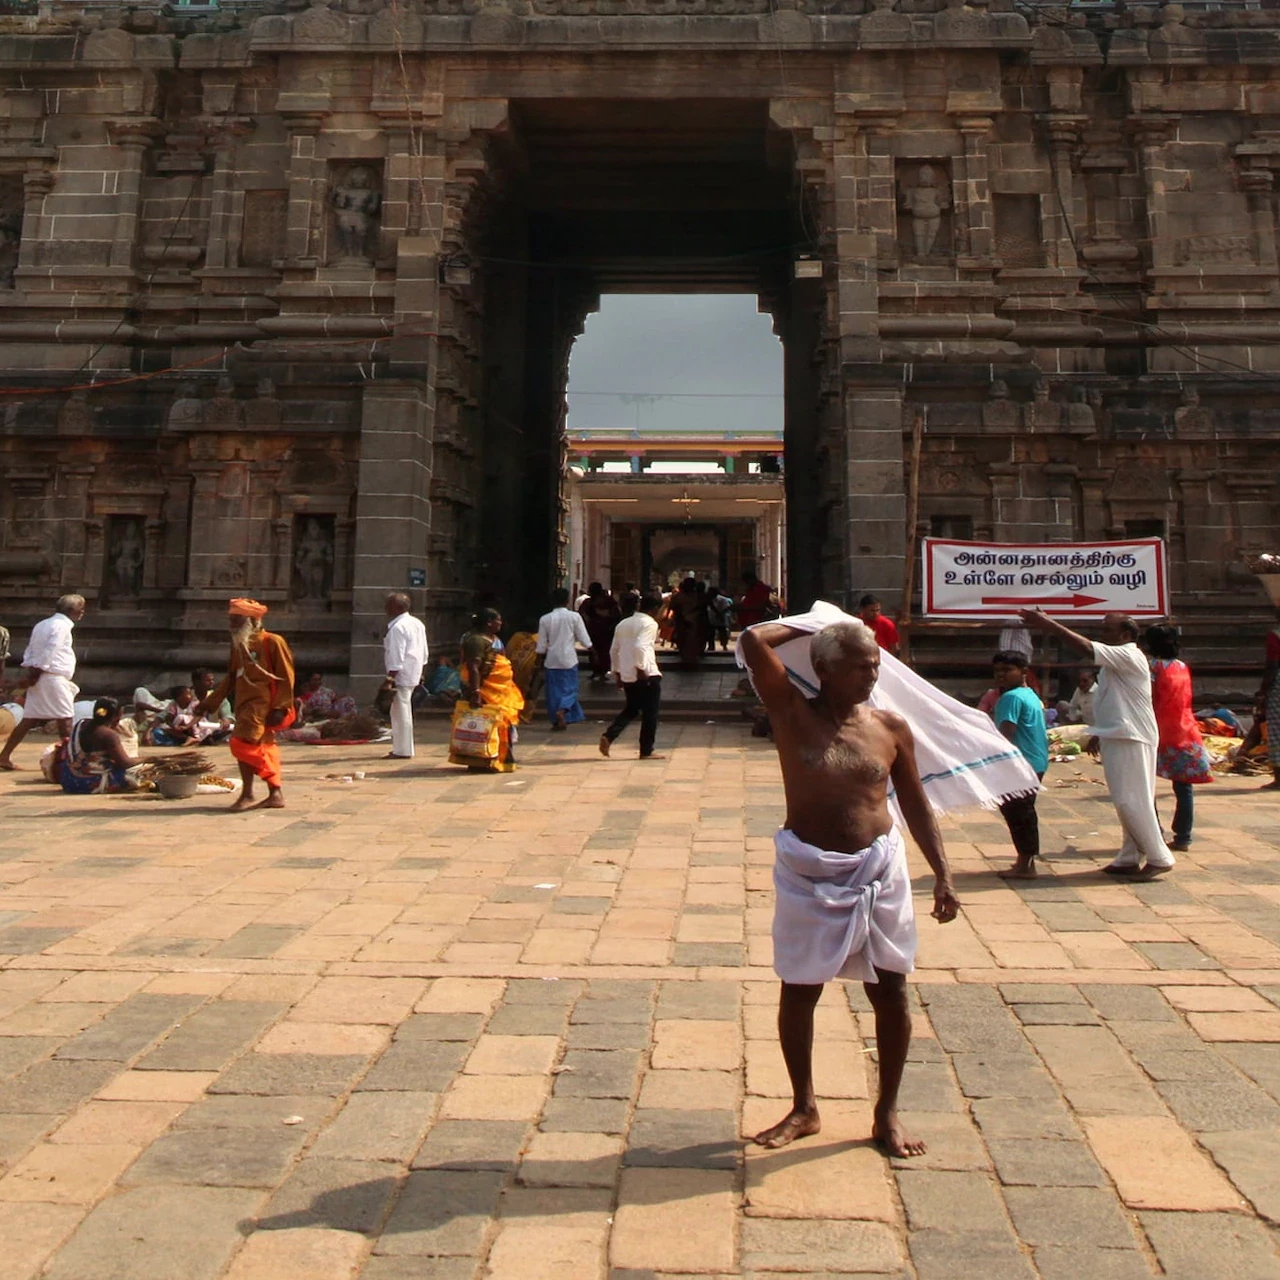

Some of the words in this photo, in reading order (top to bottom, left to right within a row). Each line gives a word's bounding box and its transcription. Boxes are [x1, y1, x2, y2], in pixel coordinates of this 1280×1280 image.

[953, 550, 1136, 569] அன்னதானத்திற்கு
[944, 570, 1016, 586] உள்ளே
[1021, 570, 1104, 591] செல்லும்
[1109, 570, 1147, 591] வழி
